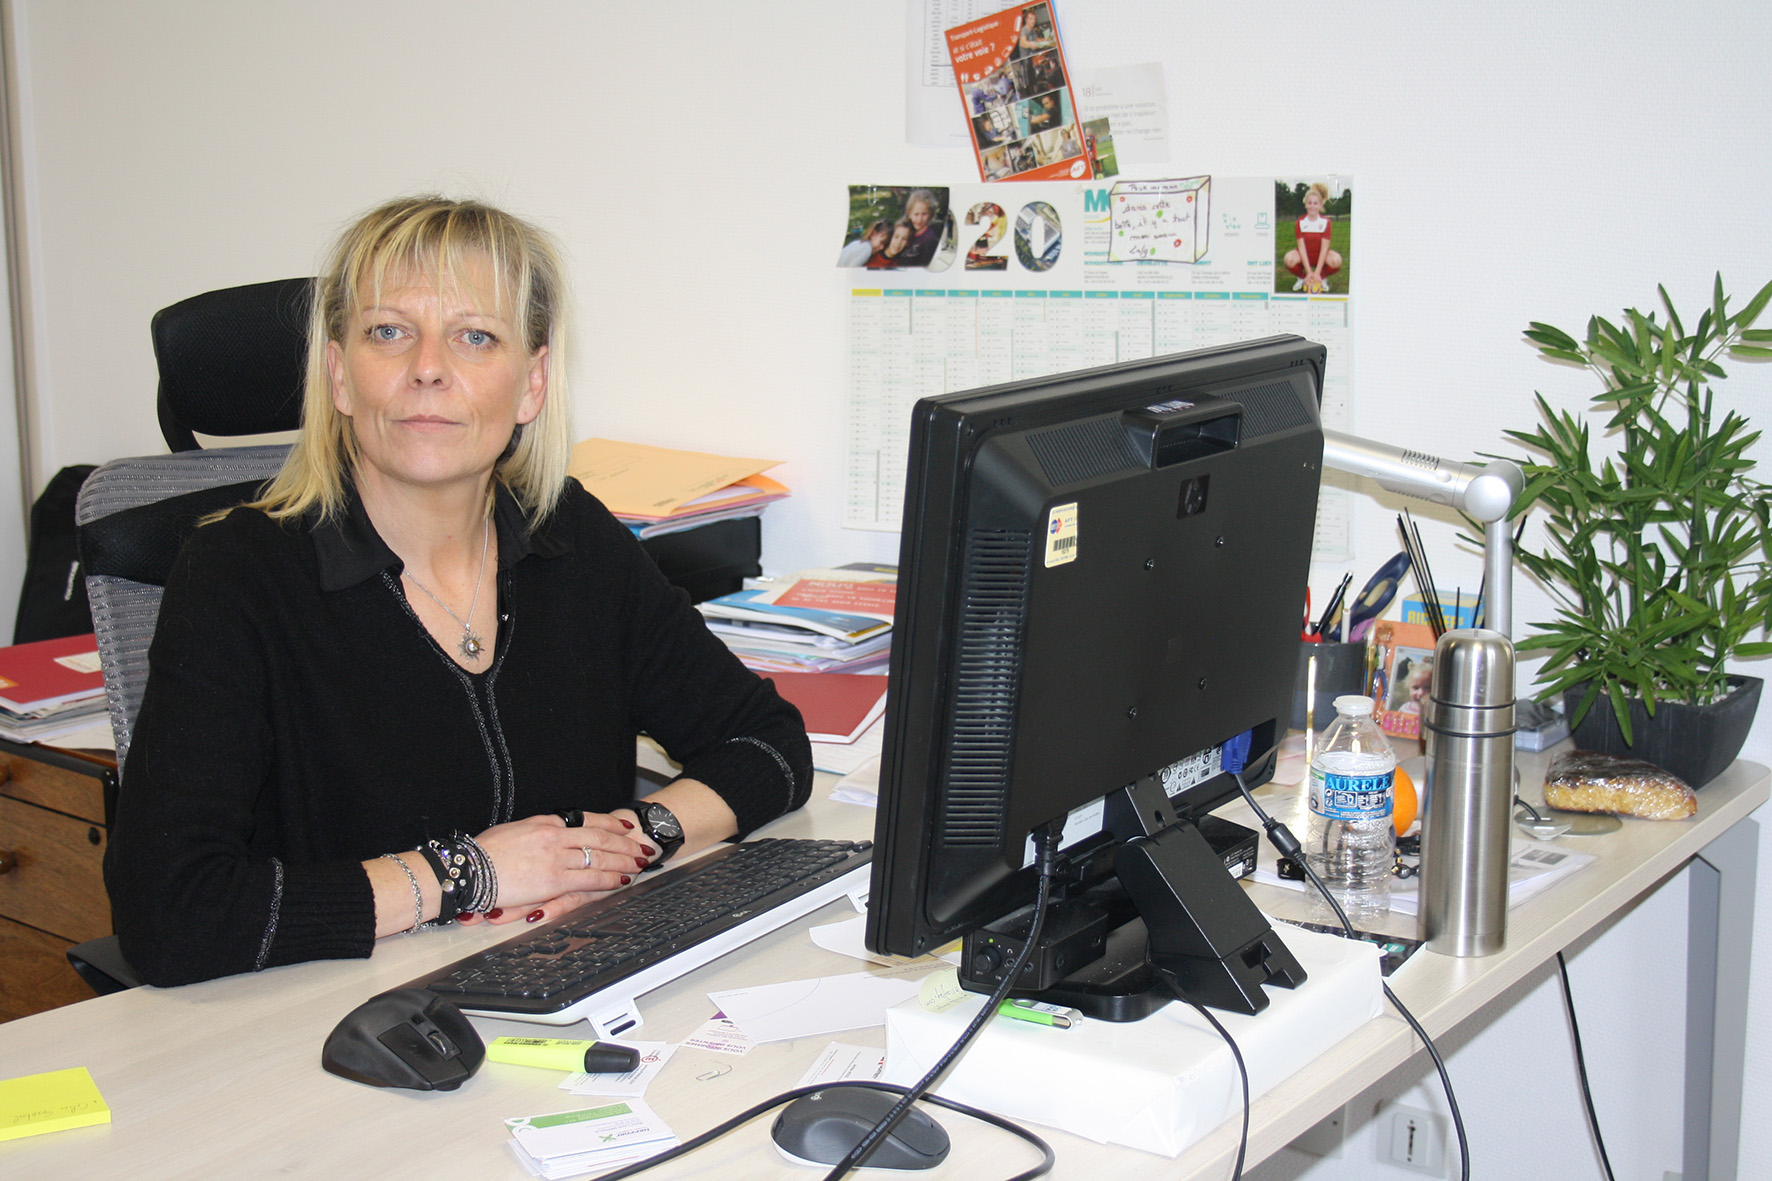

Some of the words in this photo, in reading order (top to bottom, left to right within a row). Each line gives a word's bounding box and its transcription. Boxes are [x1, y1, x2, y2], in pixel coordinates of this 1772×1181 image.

[955, 52, 974, 63] votre
[974, 46, 989, 57] voie
[1325, 776, 1390, 792] AURELE
